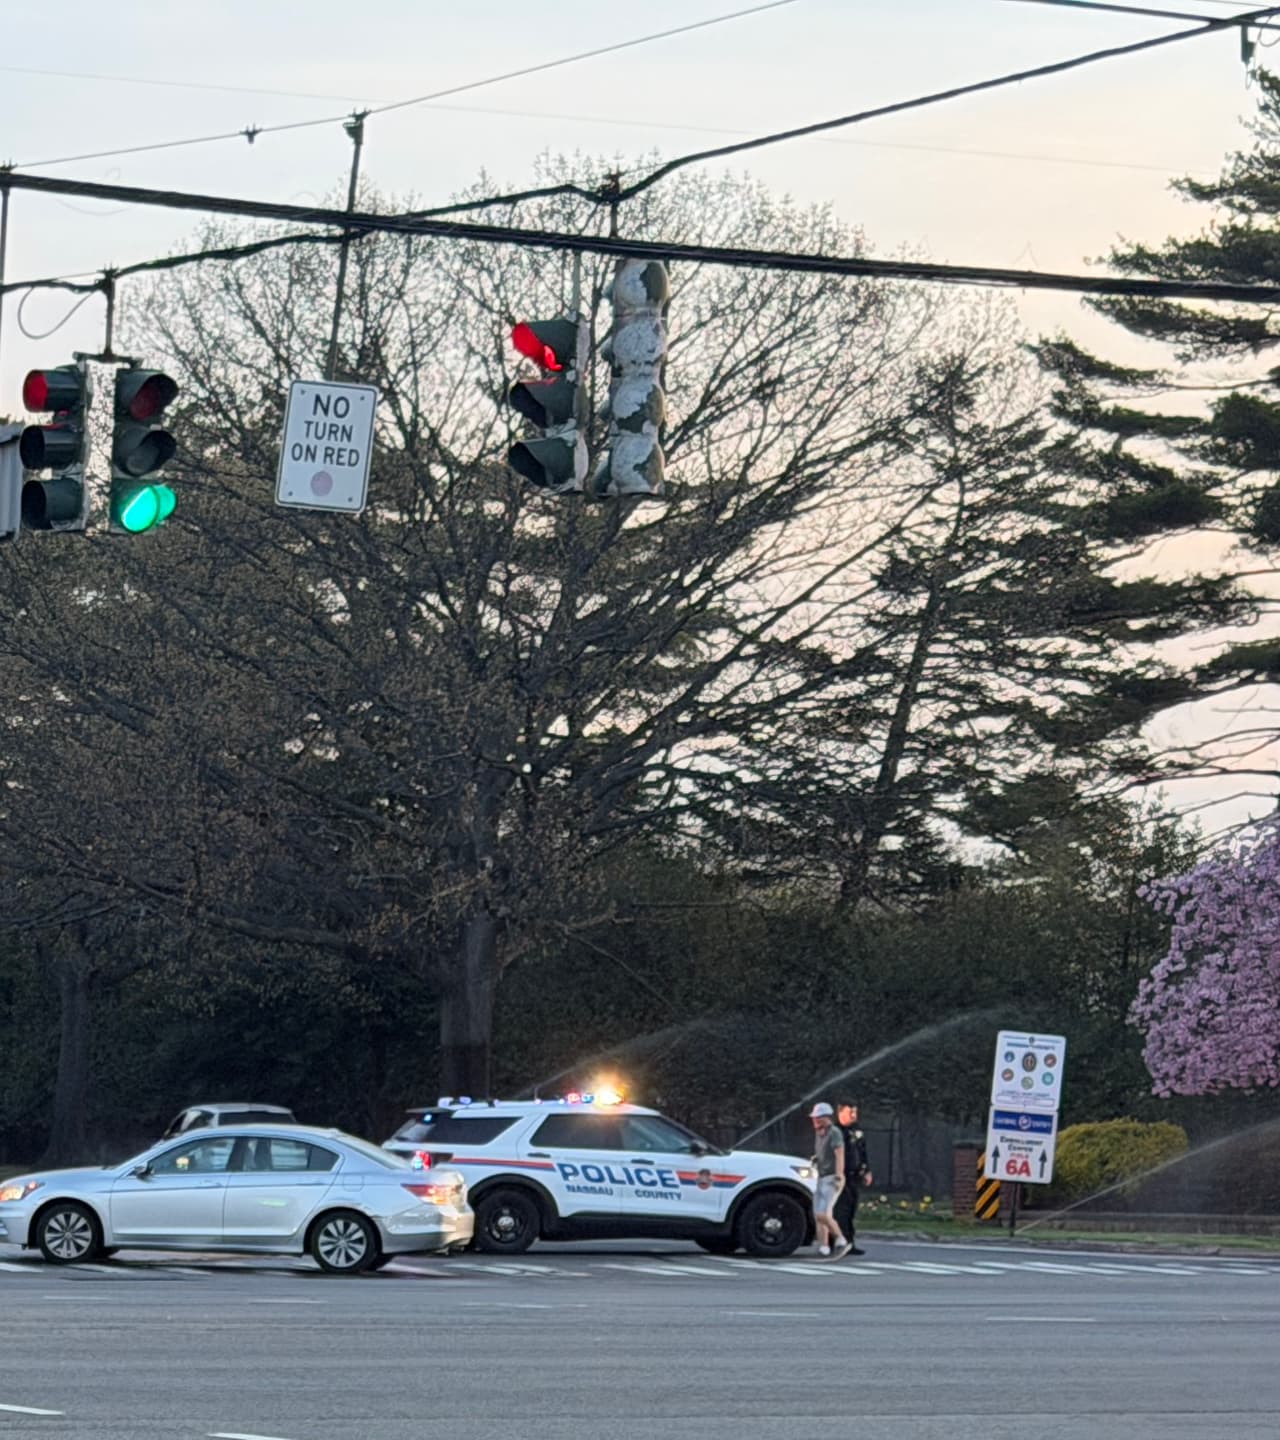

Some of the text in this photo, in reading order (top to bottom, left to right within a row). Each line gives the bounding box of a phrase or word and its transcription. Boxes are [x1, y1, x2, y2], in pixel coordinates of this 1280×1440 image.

[312, 394, 350, 419] NO
[304, 420, 354, 442] TURN
[291, 442, 360, 467] ON RED
[556, 1162, 680, 1188] POLICE
[1006, 1159, 1032, 1178] 6A
[566, 1184, 682, 1201] NASSAU COUNTY
